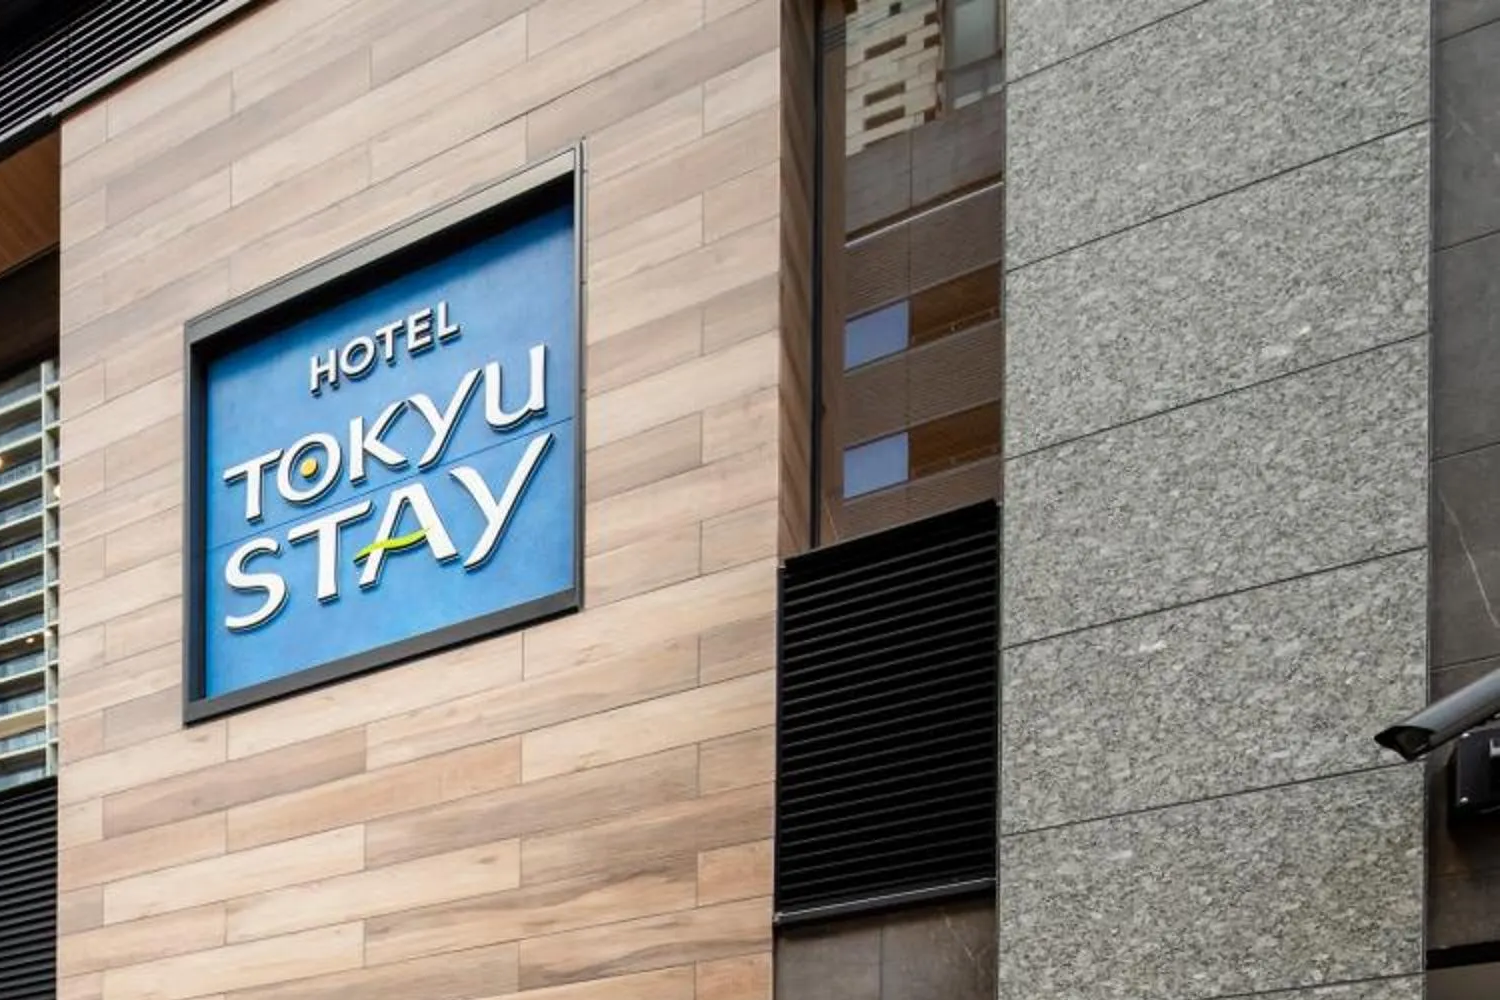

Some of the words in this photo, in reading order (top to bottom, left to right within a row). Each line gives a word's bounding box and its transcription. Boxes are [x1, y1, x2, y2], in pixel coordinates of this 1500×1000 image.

[223, 343, 548, 524] TOKYU
[309, 301, 461, 399] HOTEL
[223, 432, 554, 633] STAY
